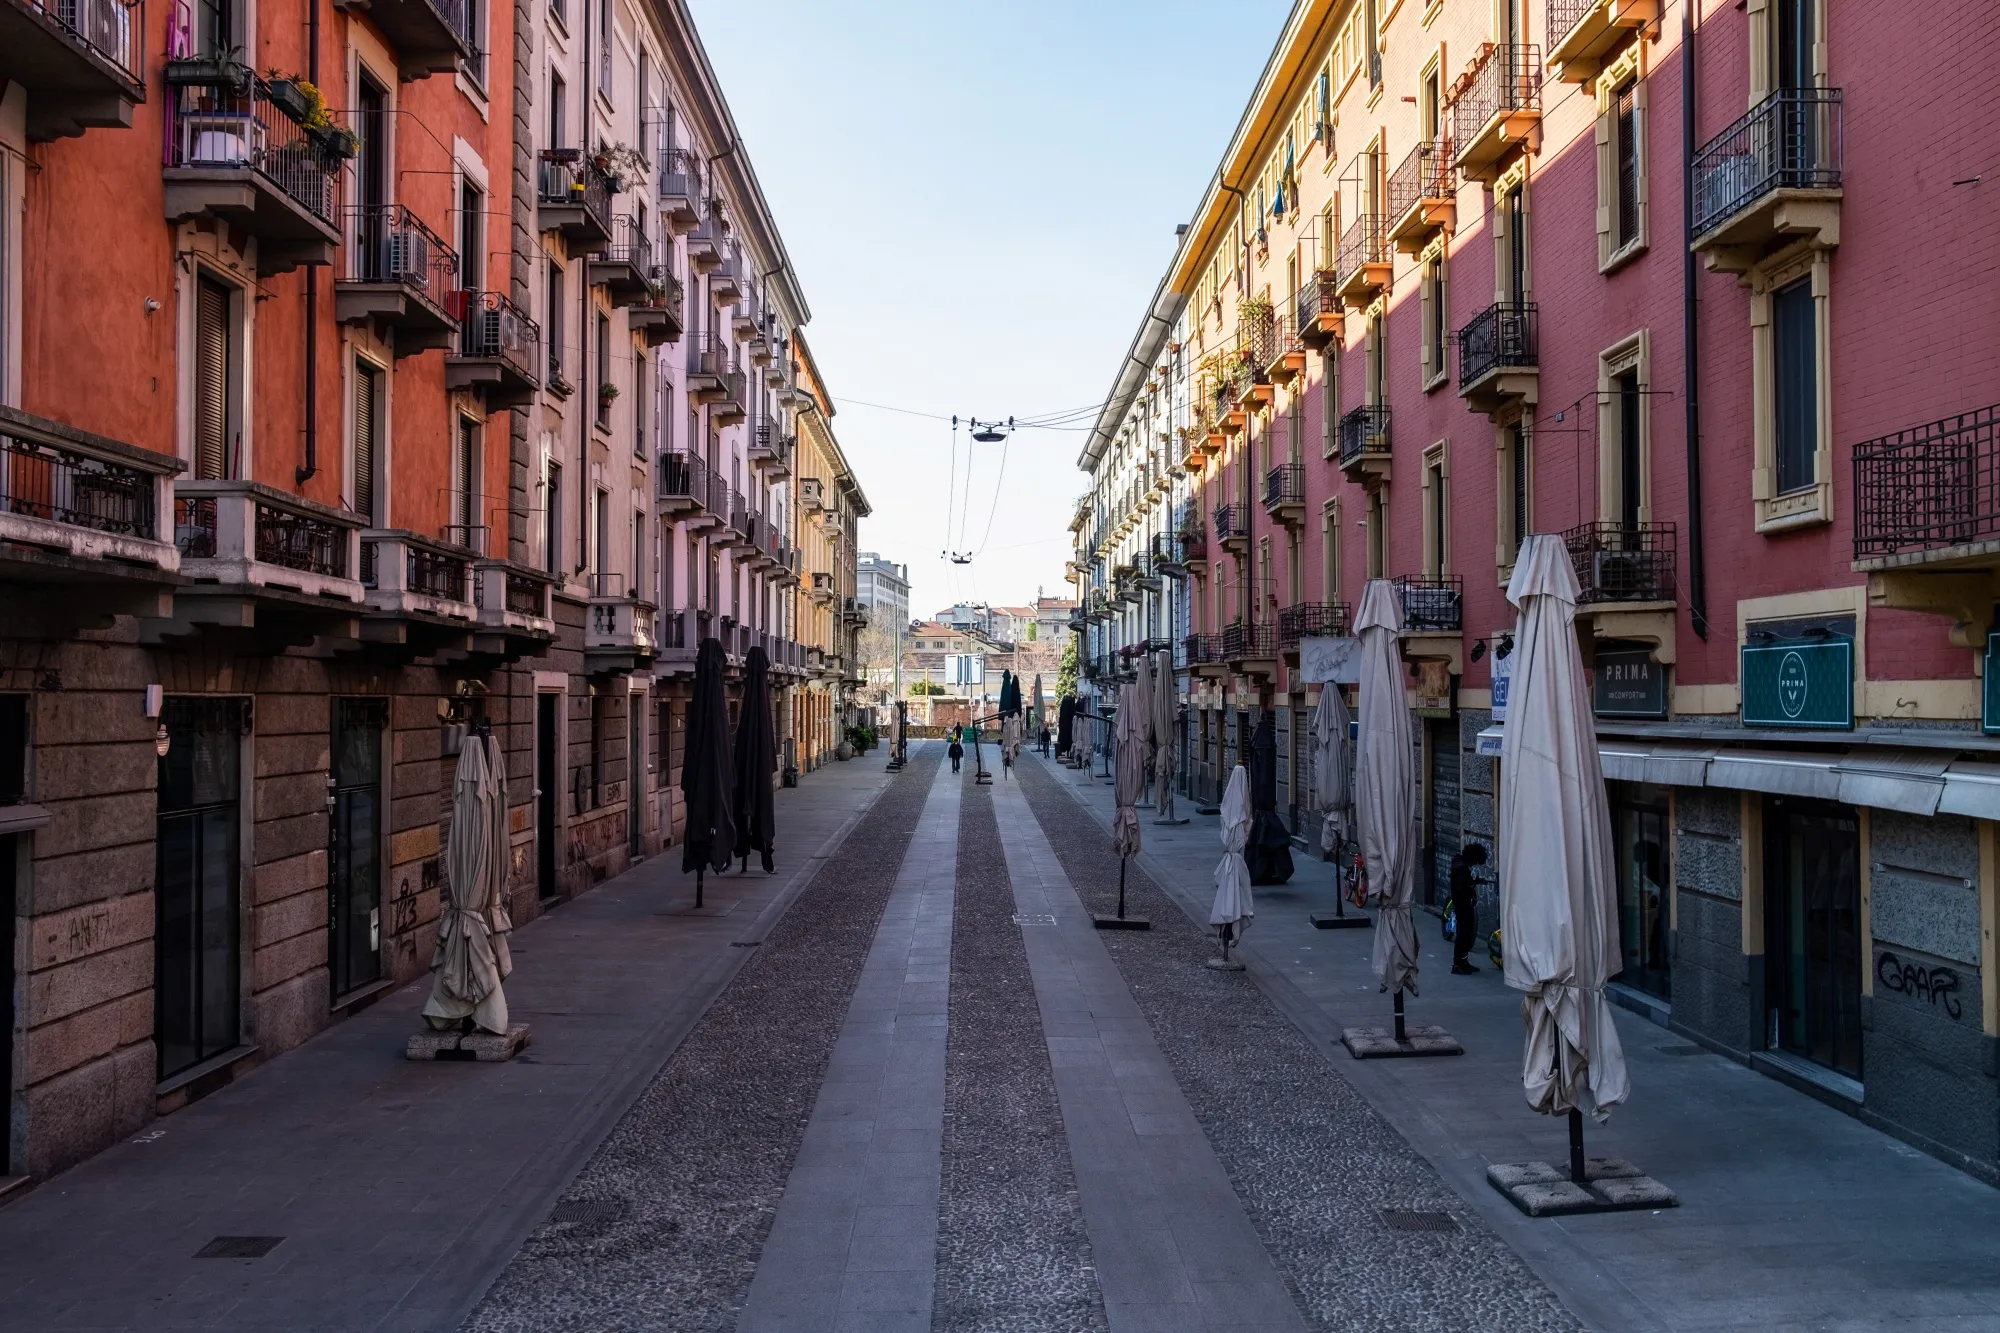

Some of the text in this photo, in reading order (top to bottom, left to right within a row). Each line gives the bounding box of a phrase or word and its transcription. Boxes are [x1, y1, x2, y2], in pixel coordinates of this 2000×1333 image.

[1606, 664, 1649, 681] PRIMA
[1781, 679, 1804, 687] PRIMA
[1614, 691, 1640, 700] COMFORT
